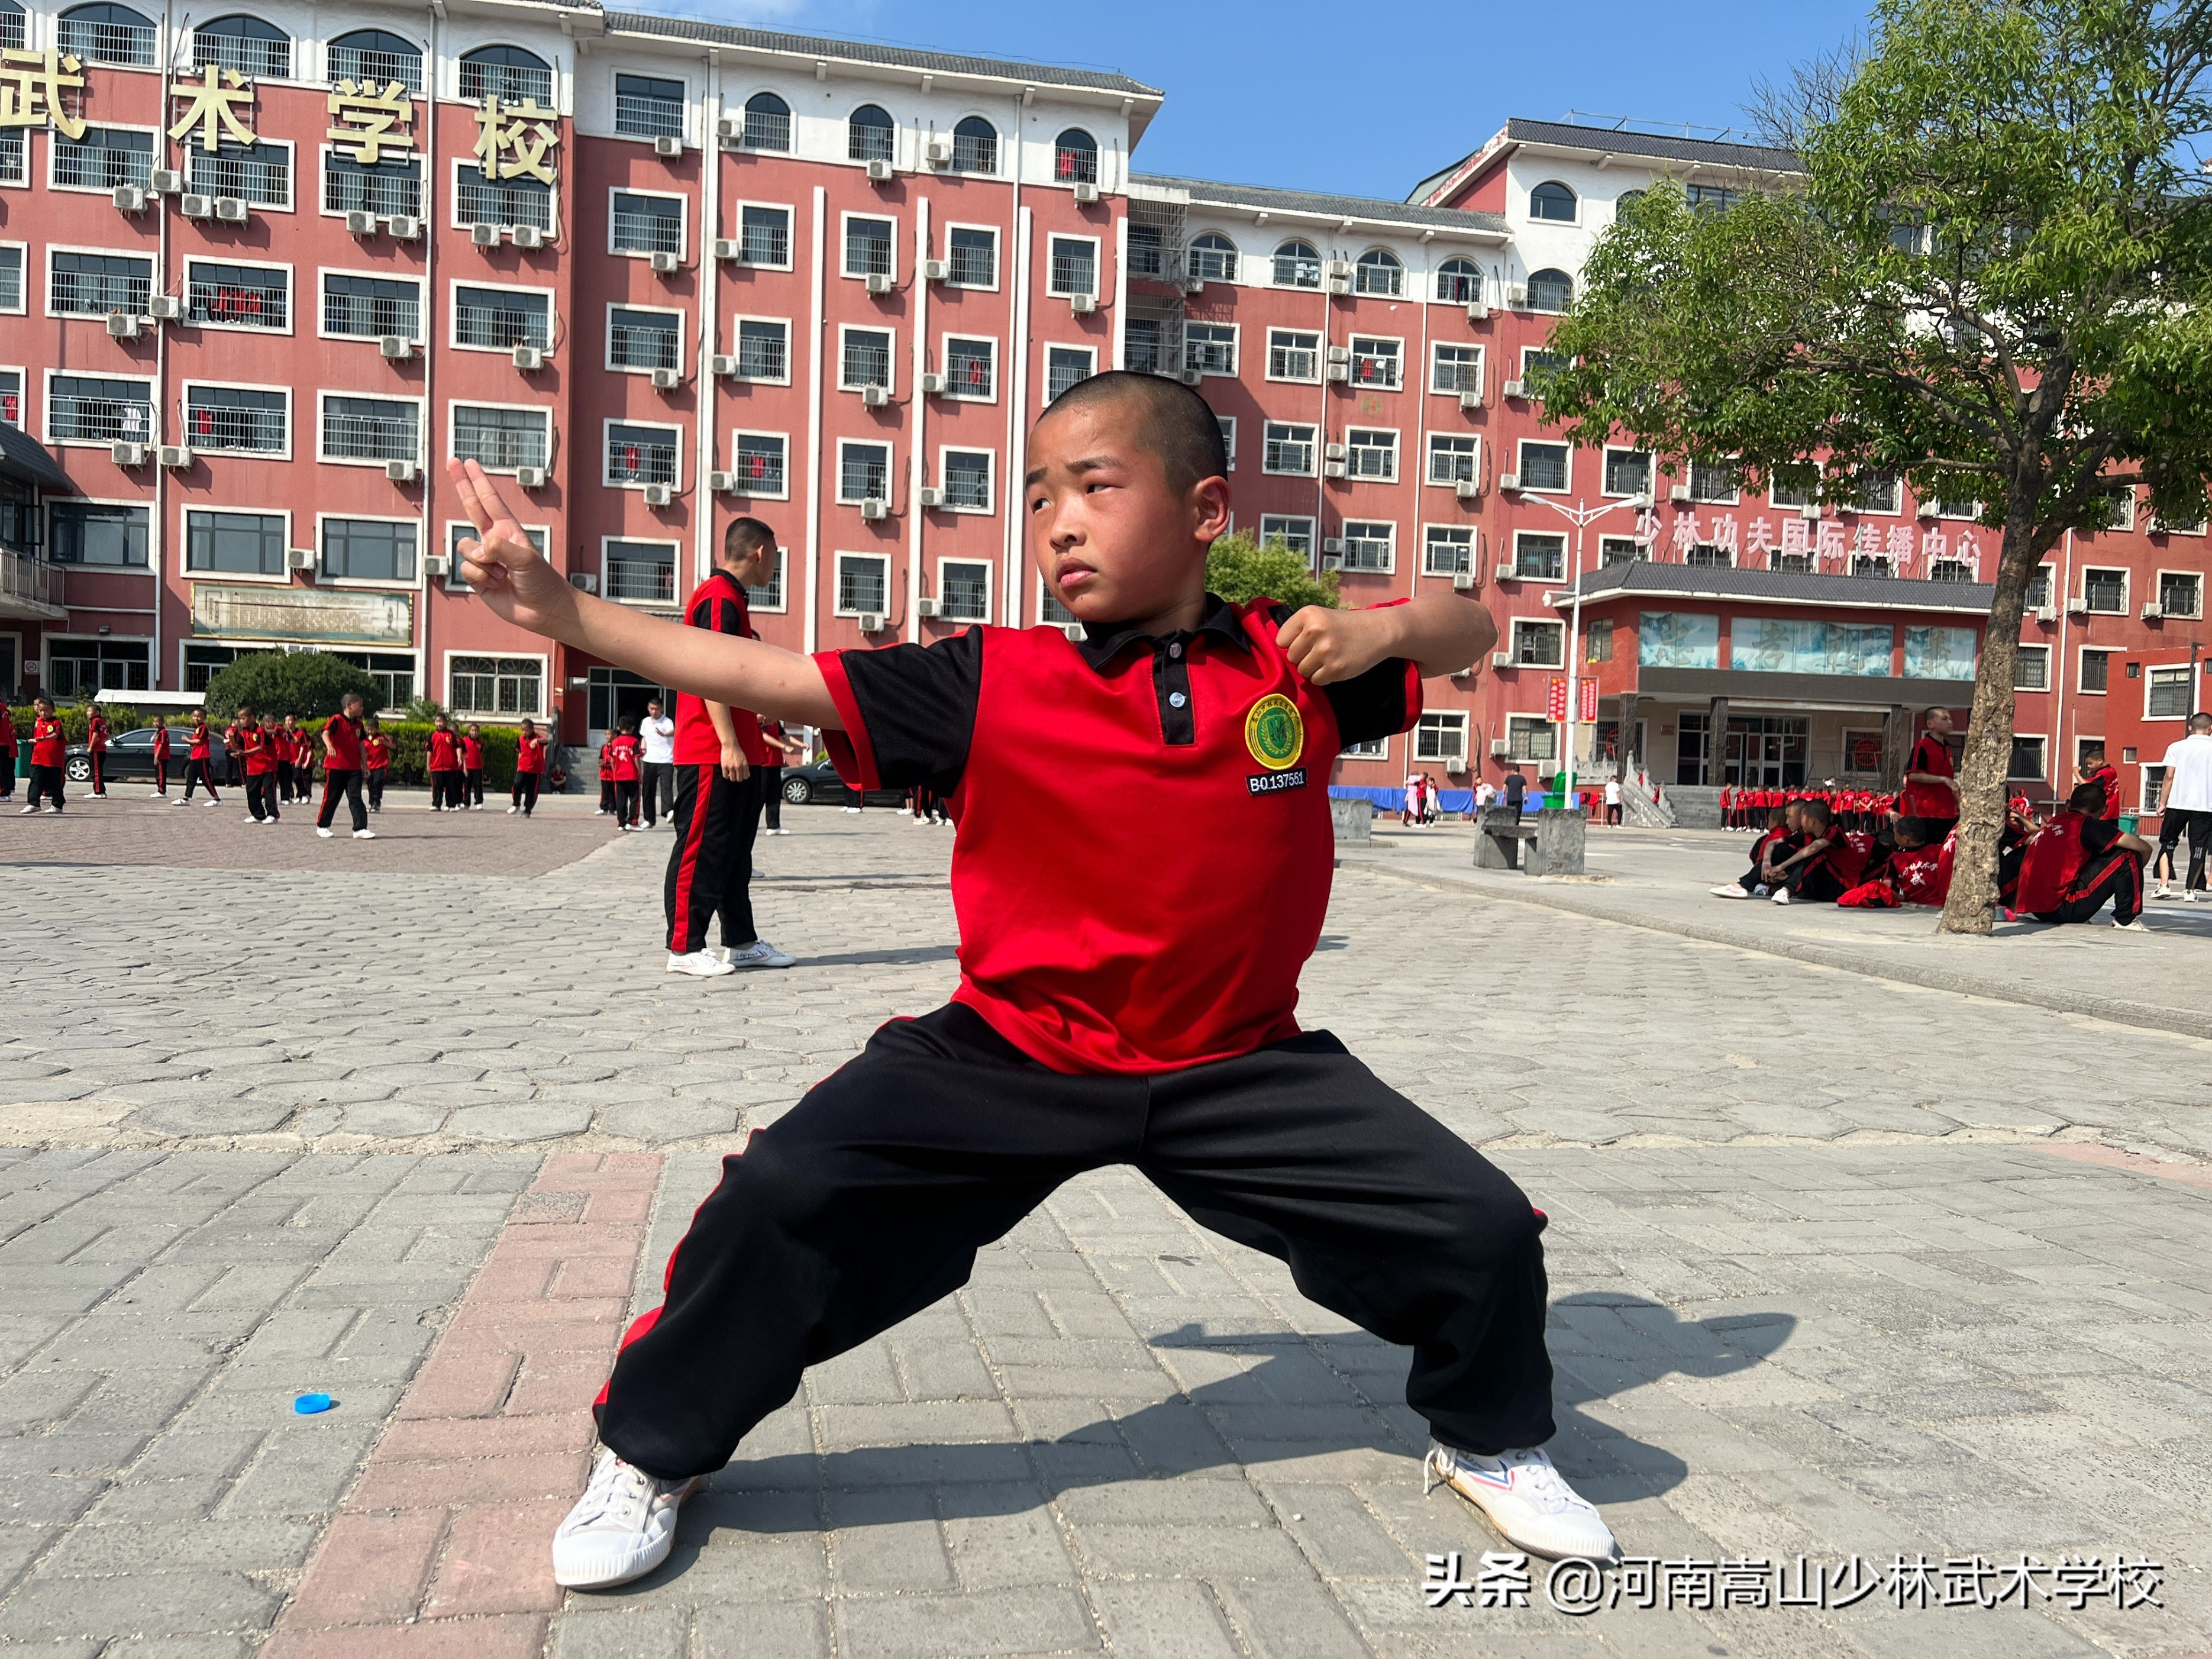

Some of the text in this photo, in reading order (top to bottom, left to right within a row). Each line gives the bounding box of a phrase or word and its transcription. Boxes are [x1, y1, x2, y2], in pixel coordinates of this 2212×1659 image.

[0, 48, 560, 186] 武术学校
[1634, 508, 1982, 568] 少林功夫国际传播中心
